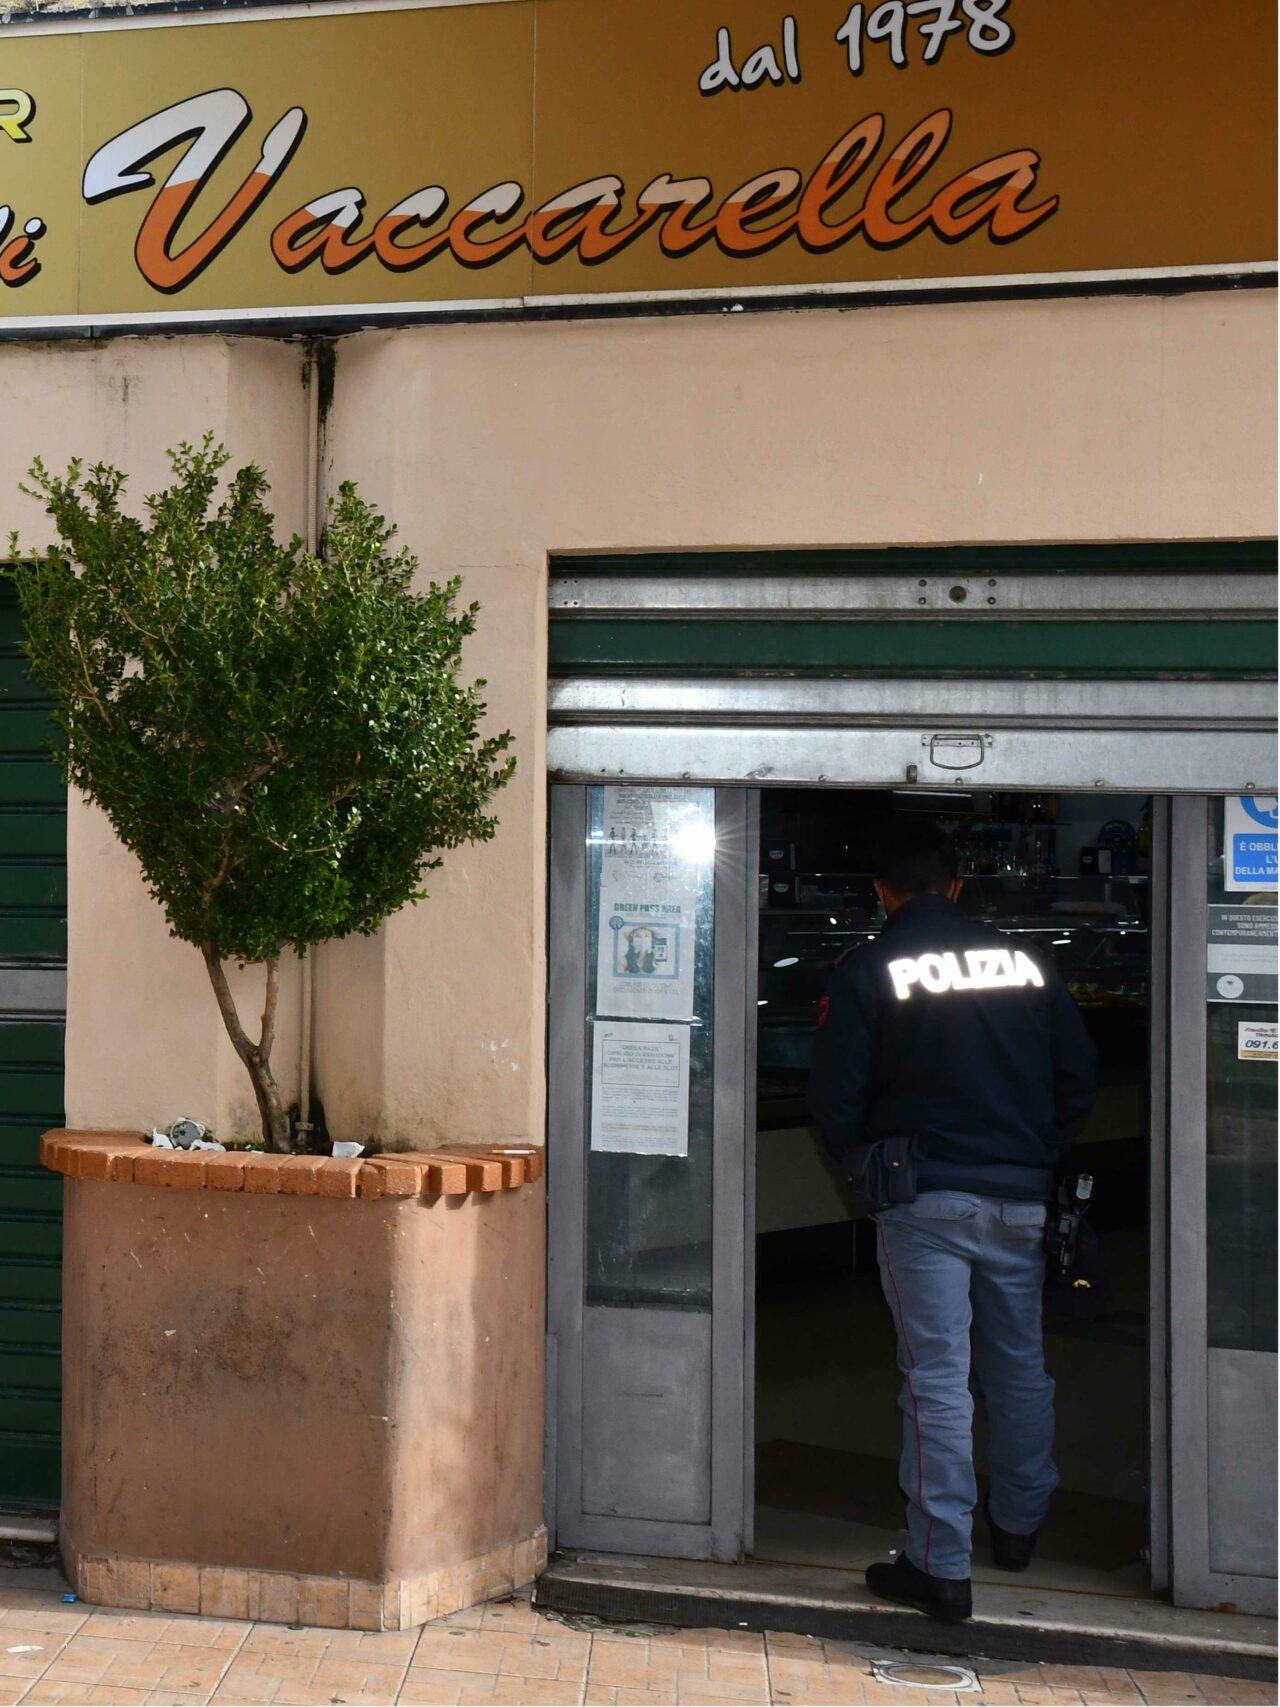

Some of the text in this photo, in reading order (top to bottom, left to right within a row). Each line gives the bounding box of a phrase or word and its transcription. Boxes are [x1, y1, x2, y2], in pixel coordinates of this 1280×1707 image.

[698, 0, 1015, 97] dal 1978
[81, 86, 1058, 295] Vaccarella
[1234, 866, 1265, 875] DELLA
[613, 903, 639, 912] GREEN
[639, 904, 660, 914] PASS
[888, 949, 1045, 1000] POLIZIA
